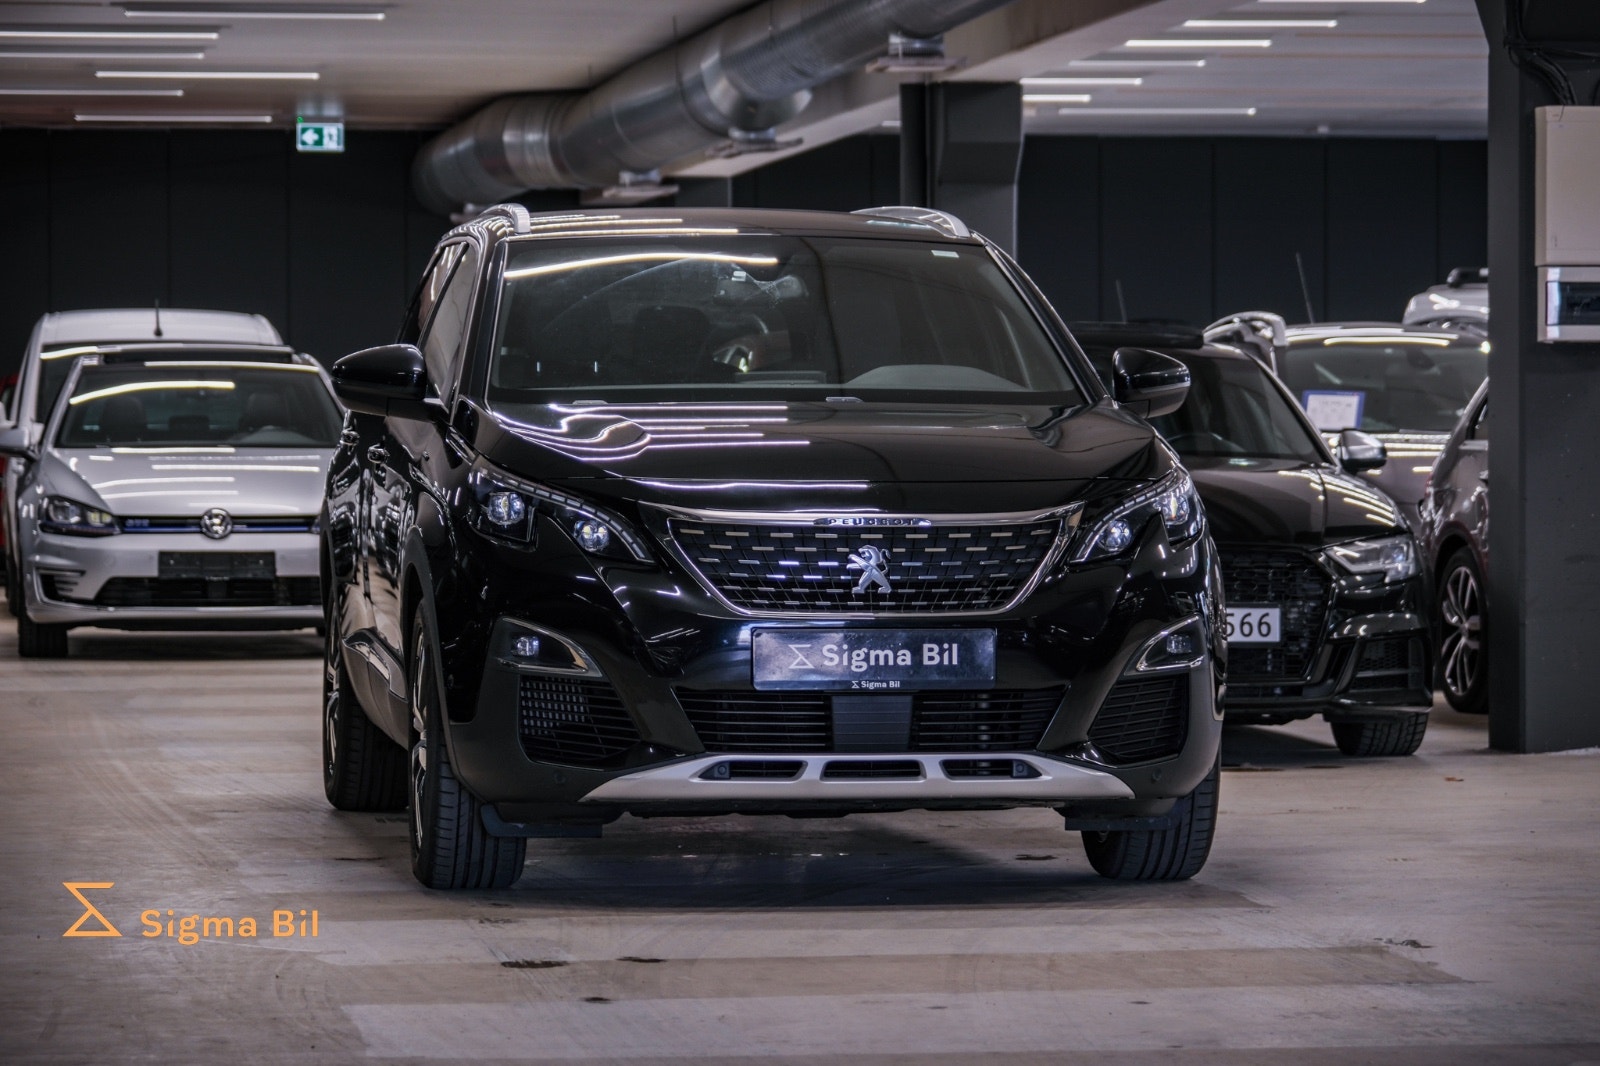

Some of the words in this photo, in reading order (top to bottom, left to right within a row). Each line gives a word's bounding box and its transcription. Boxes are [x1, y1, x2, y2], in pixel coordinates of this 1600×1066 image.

[1226, 612, 1271, 638] 566
[822, 643, 912, 672] Sigma
[922, 643, 958, 665] Bil
[861, 680, 887, 689] Sigma
[889, 680, 900, 688] Bil
